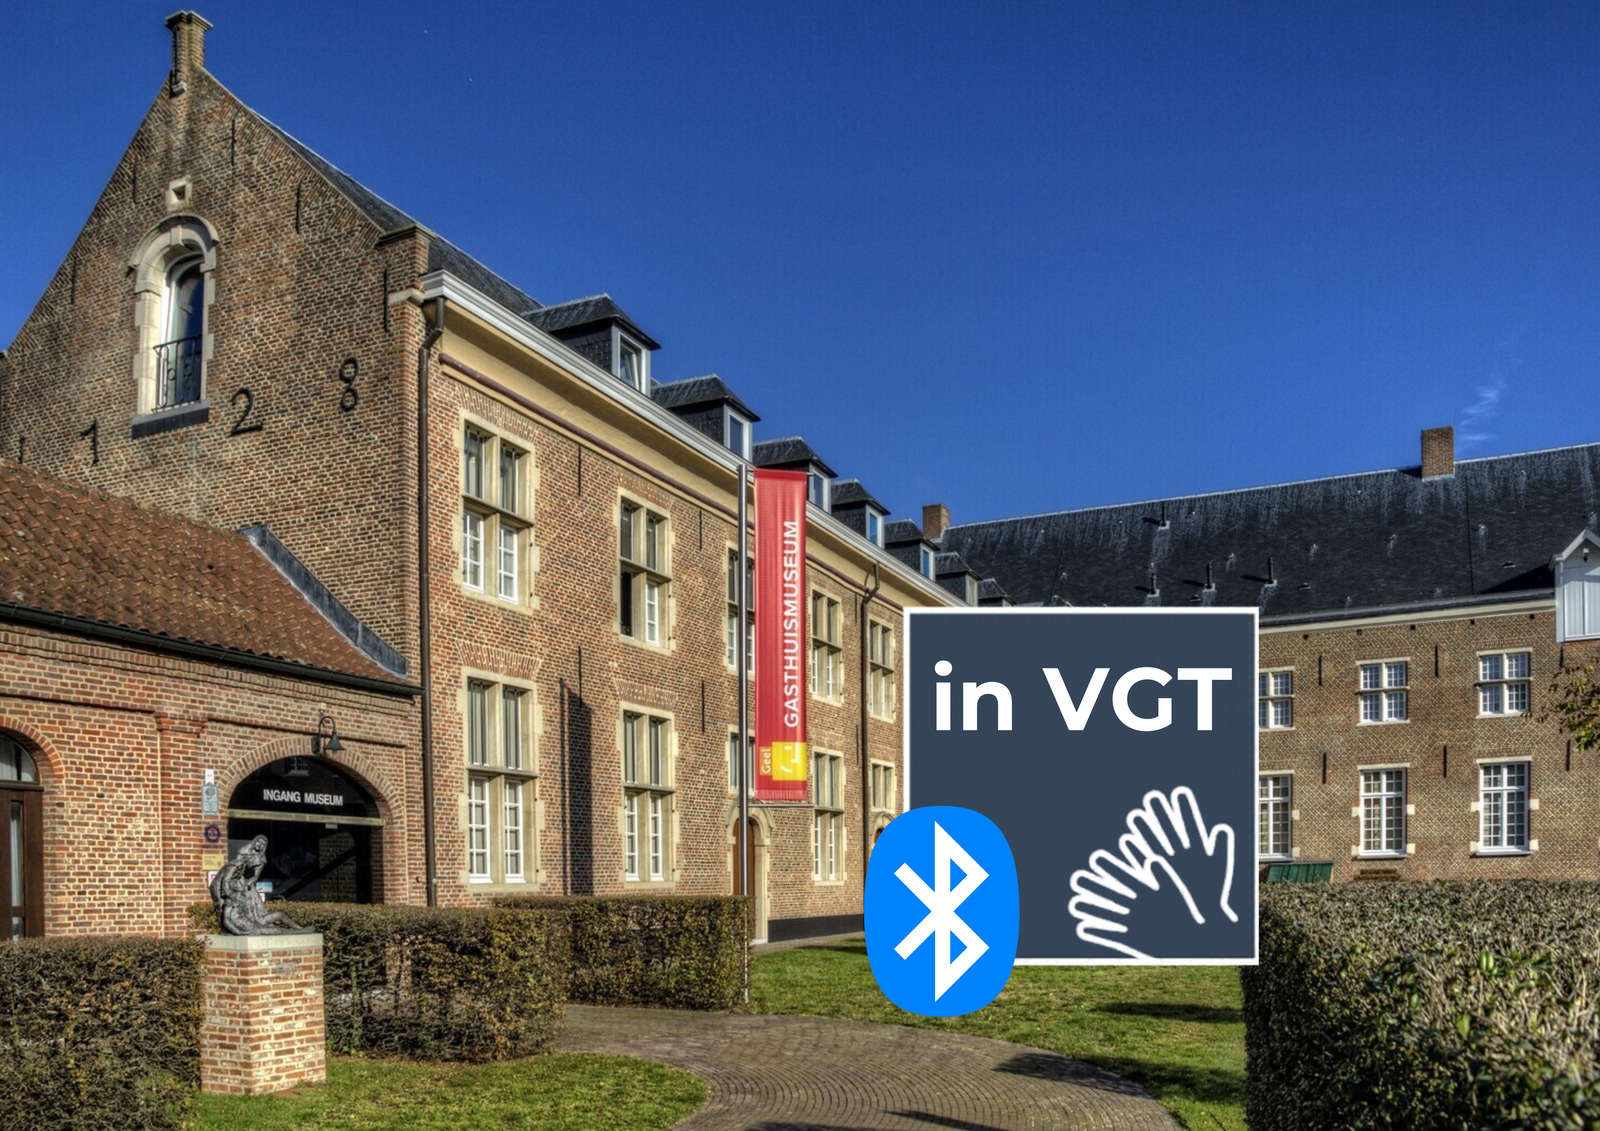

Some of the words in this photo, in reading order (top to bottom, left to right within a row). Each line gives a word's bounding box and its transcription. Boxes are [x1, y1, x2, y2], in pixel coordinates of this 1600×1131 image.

[230, 387, 263, 437] 2
[339, 356, 359, 412] 8
[783, 521, 799, 727] GASTHUISMUSEUM
[761, 748, 771, 774] Geel
[263, 789, 301, 803] INGANG
[304, 793, 343, 806] MUSEUM
